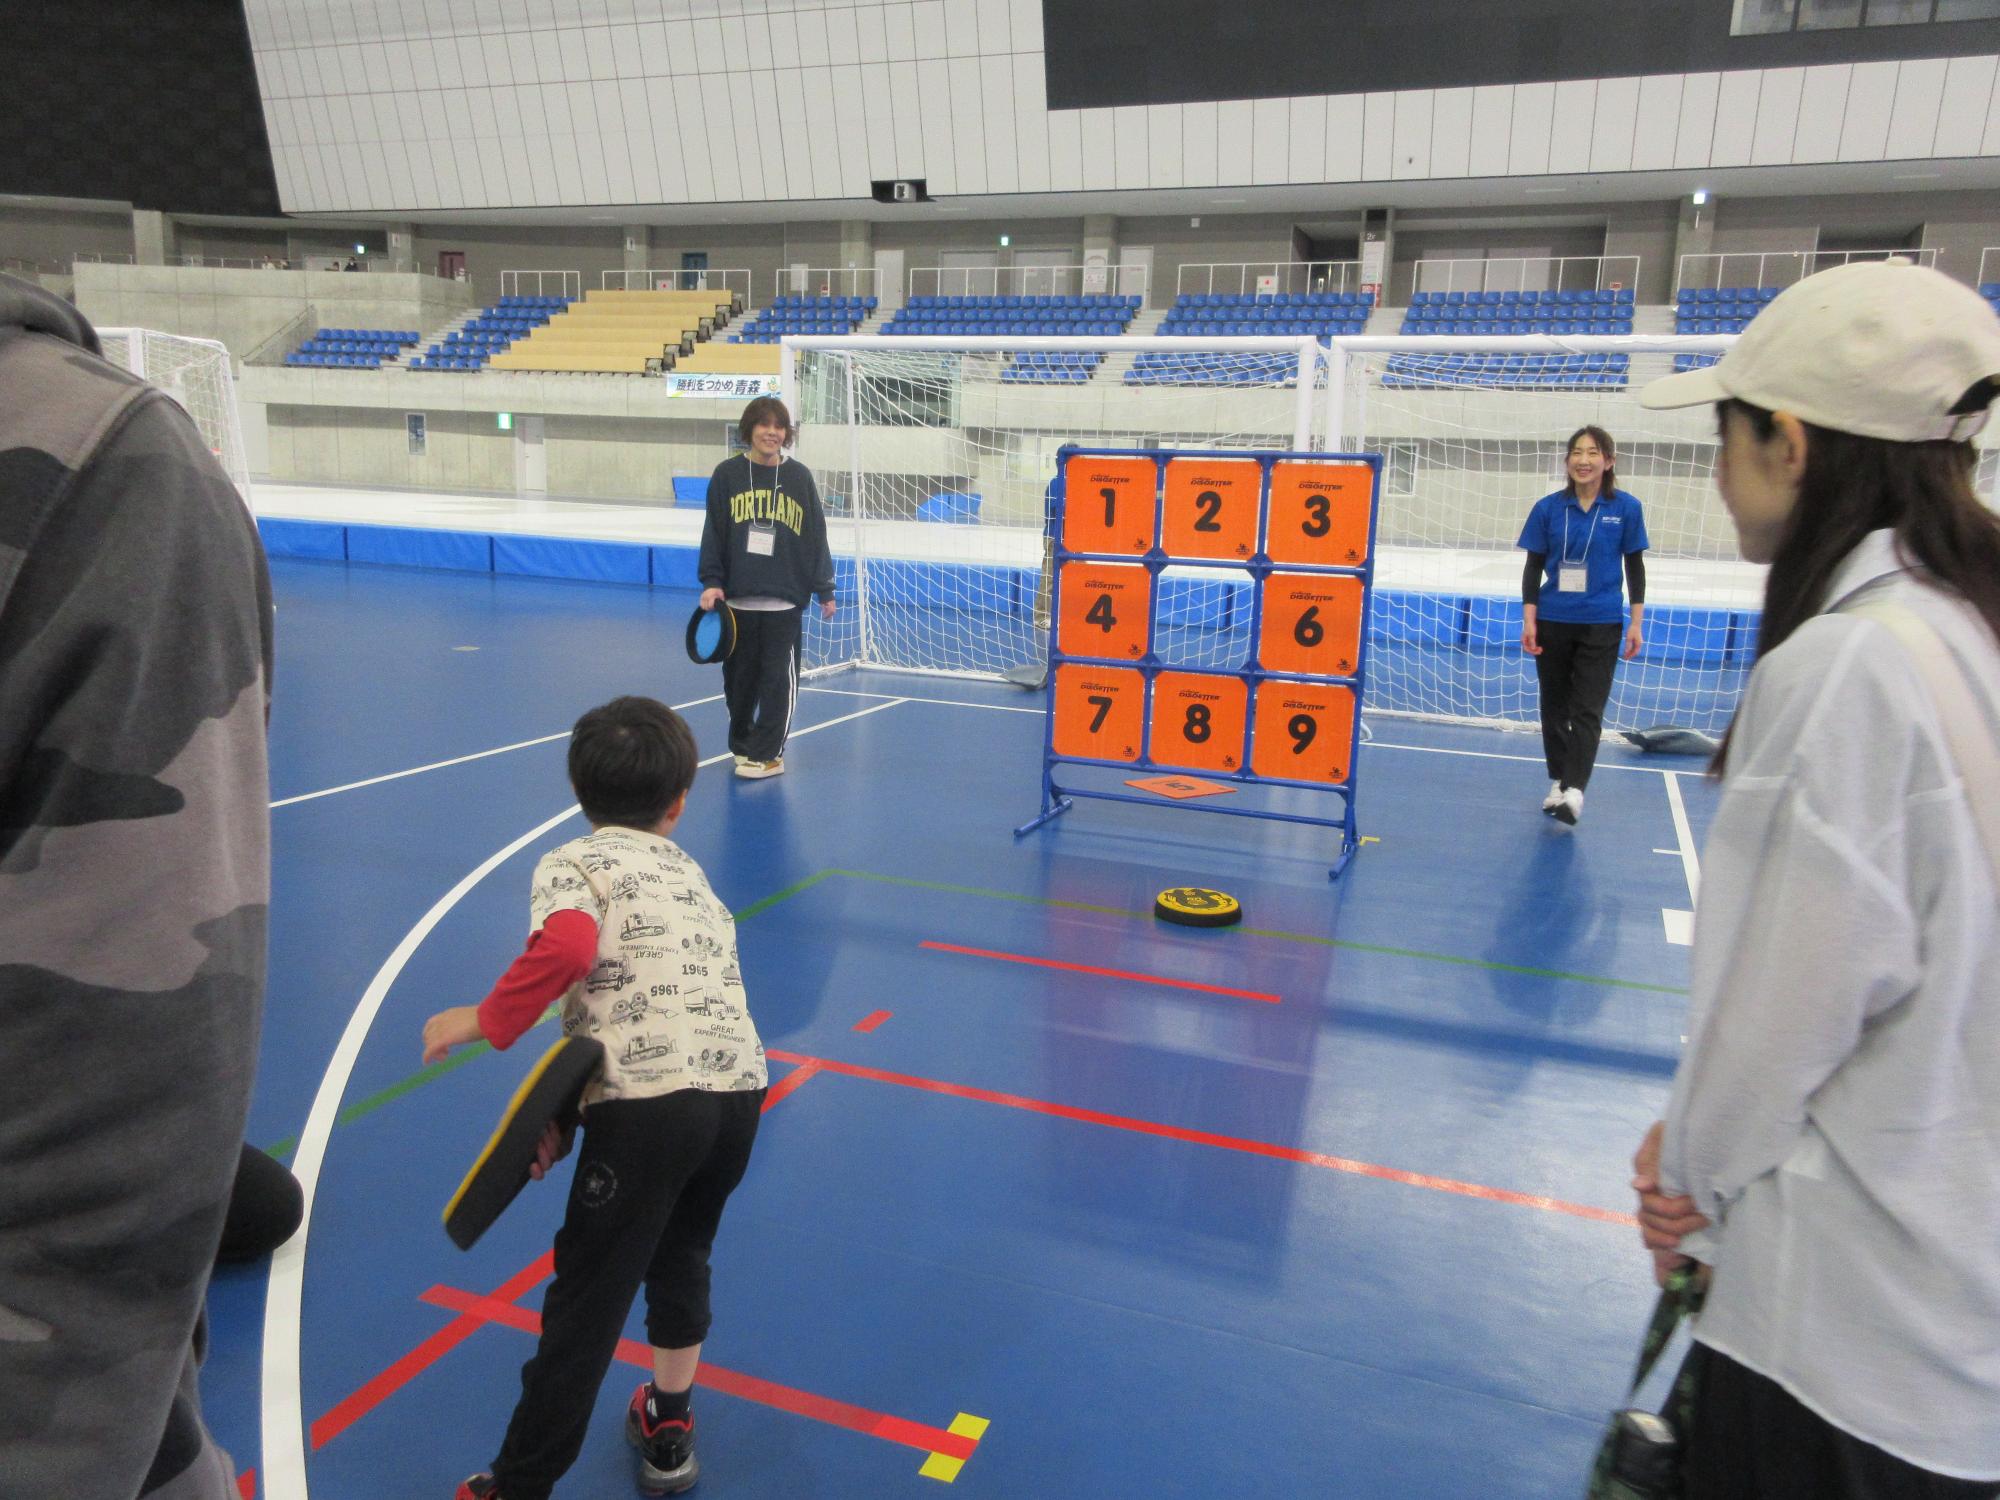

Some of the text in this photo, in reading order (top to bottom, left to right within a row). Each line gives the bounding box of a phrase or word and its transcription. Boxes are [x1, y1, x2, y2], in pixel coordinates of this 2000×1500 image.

[1100, 488, 1116, 528] 1
[1194, 491, 1222, 532] 2
[1302, 495, 1331, 537] 3
[1085, 594, 1117, 633] 4
[1294, 605, 1324, 648] 6
[1088, 695, 1113, 733] 7
[1183, 703, 1211, 744] 8
[1288, 714, 1317, 755] 9
[633, 951, 663, 959] GREAT
[650, 984, 679, 997] 1965
[694, 1028, 717, 1038] EXPERT
[710, 1024, 735, 1035] GREAT
